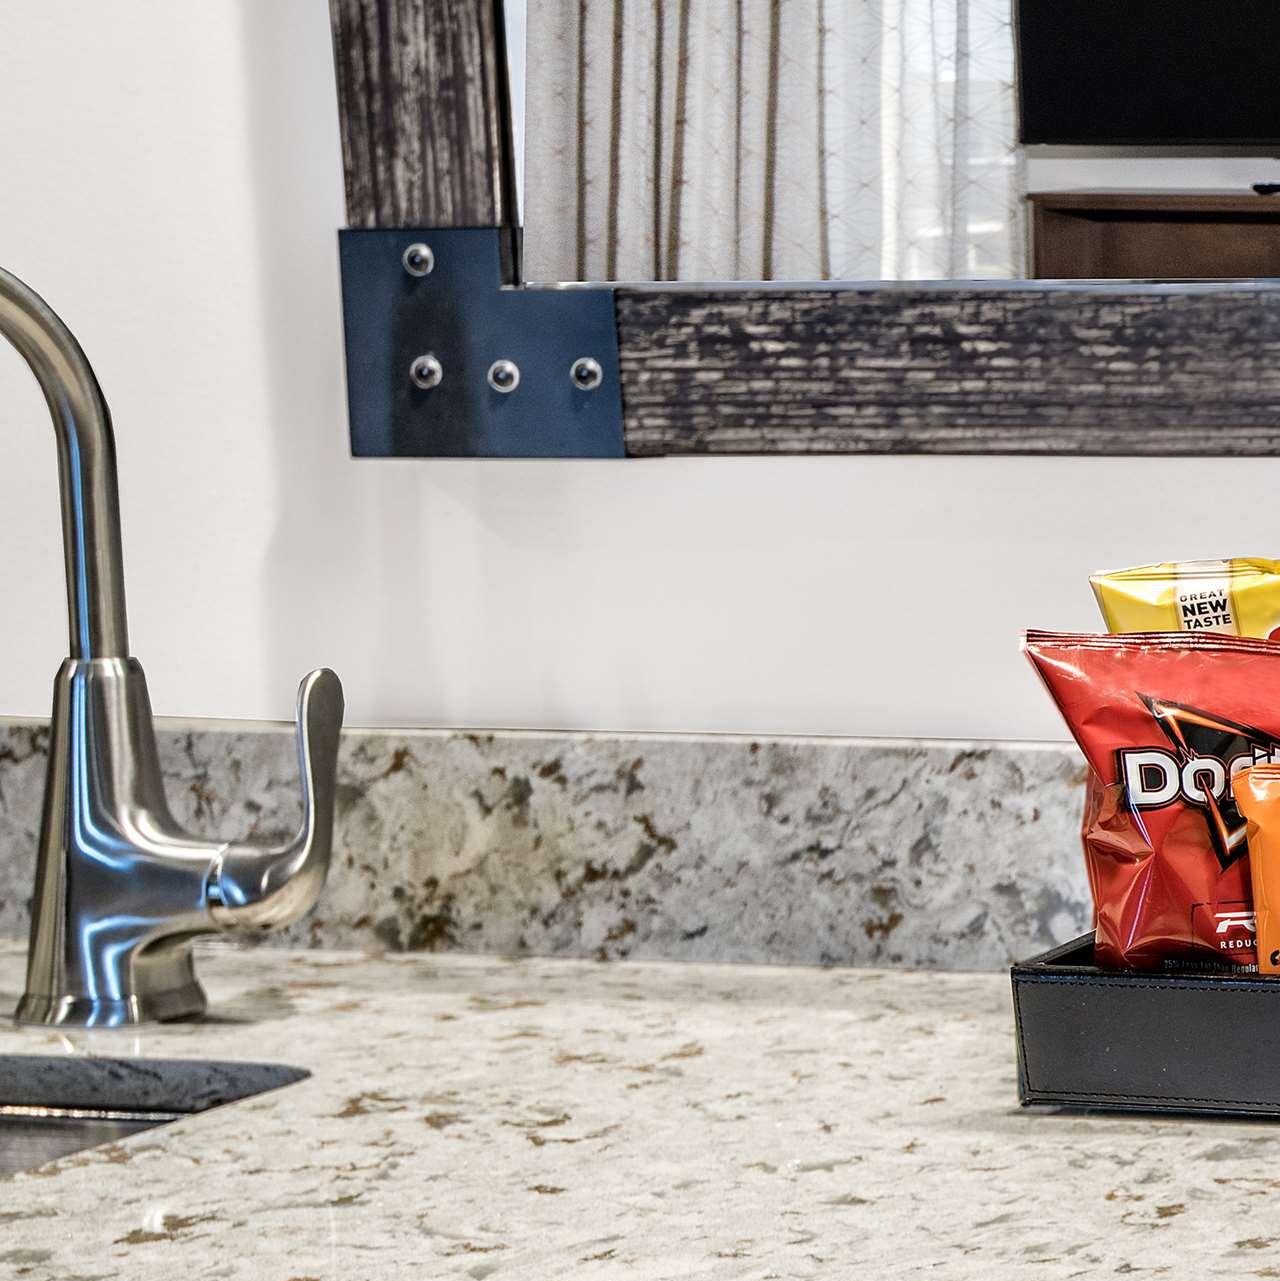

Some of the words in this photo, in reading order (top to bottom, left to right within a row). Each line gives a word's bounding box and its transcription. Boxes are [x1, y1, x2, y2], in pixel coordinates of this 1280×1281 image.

[1180, 589, 1225, 602] GREAT
[1182, 598, 1227, 617] NEW
[1184, 614, 1232, 630] TASTE
